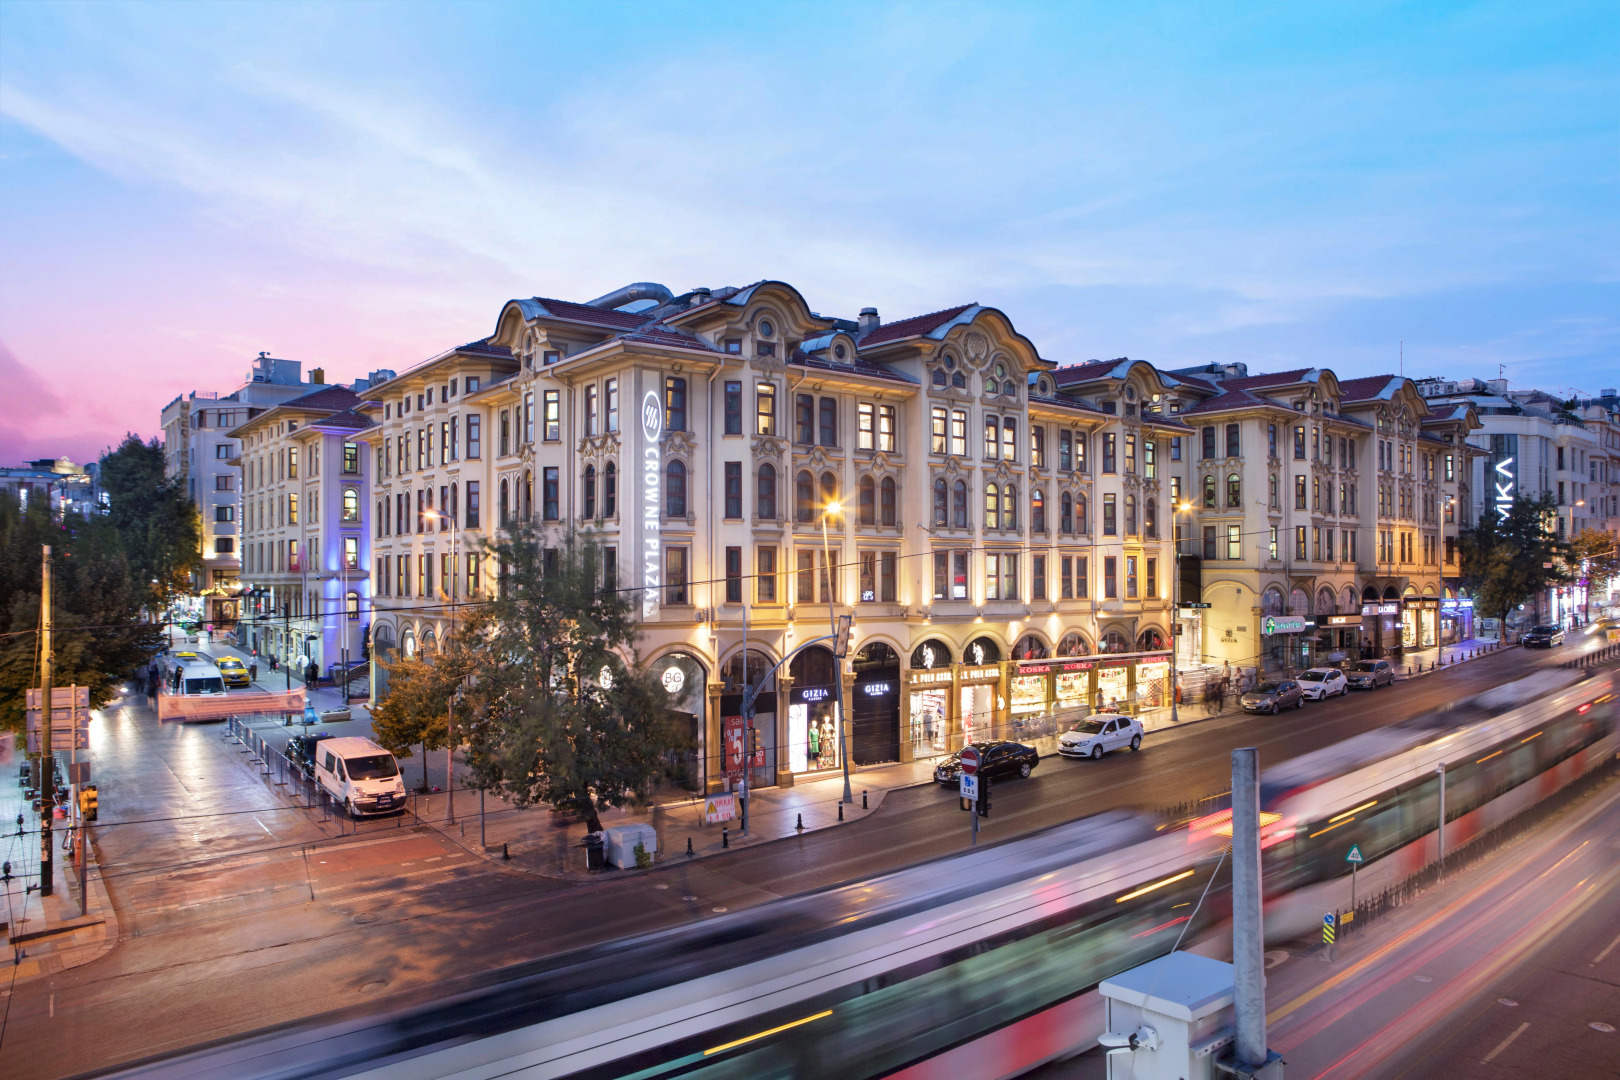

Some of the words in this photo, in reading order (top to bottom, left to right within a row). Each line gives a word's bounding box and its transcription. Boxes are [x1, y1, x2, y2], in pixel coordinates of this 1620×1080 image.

[644, 447, 660, 530] CROWNE
[644, 538, 660, 600] PLAZA
[1142, 656, 1168, 664] KOSKA
[1019, 665, 1051, 674] KOSKA
[1063, 662, 1093, 671] KOSKA
[865, 683, 889, 692] GIZIA
[803, 689, 828, 698] GIZIA
[731, 716, 744, 726] sal
